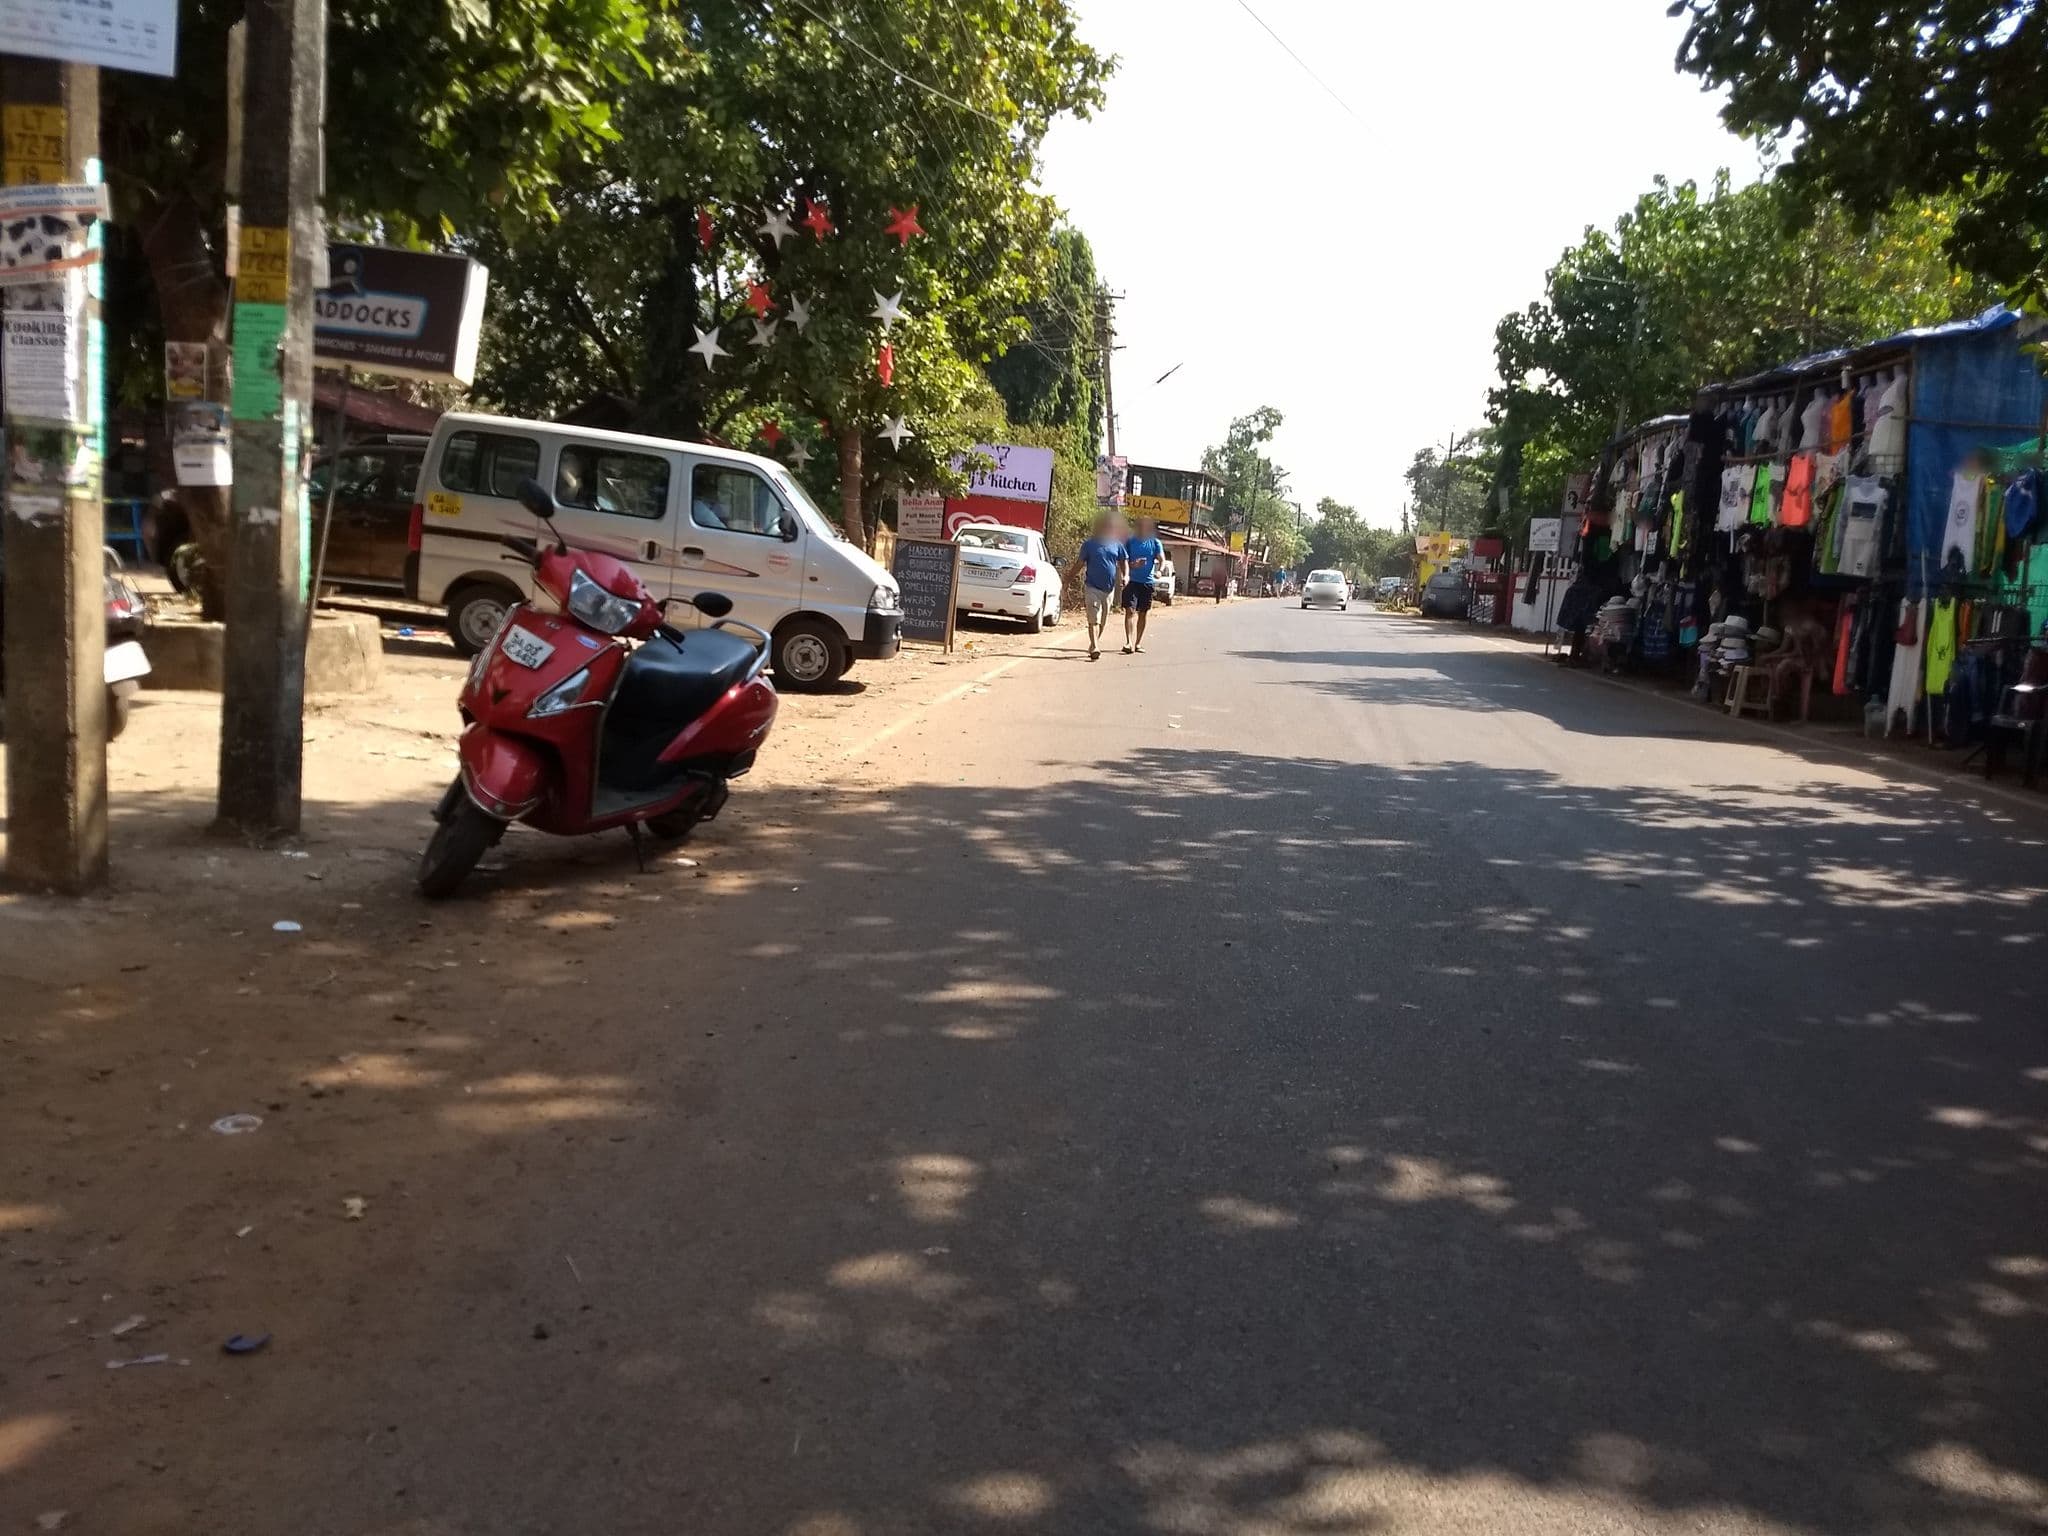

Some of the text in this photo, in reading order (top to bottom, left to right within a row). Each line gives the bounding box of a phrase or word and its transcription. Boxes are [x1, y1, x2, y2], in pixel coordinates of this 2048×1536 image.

[4, 319, 67, 336] Cooking
[988, 473, 1037, 492] Kitchen
[909, 559, 951, 573] BURGERS
[904, 596, 936, 607] WRAPS
[917, 608, 933, 617] DAY
